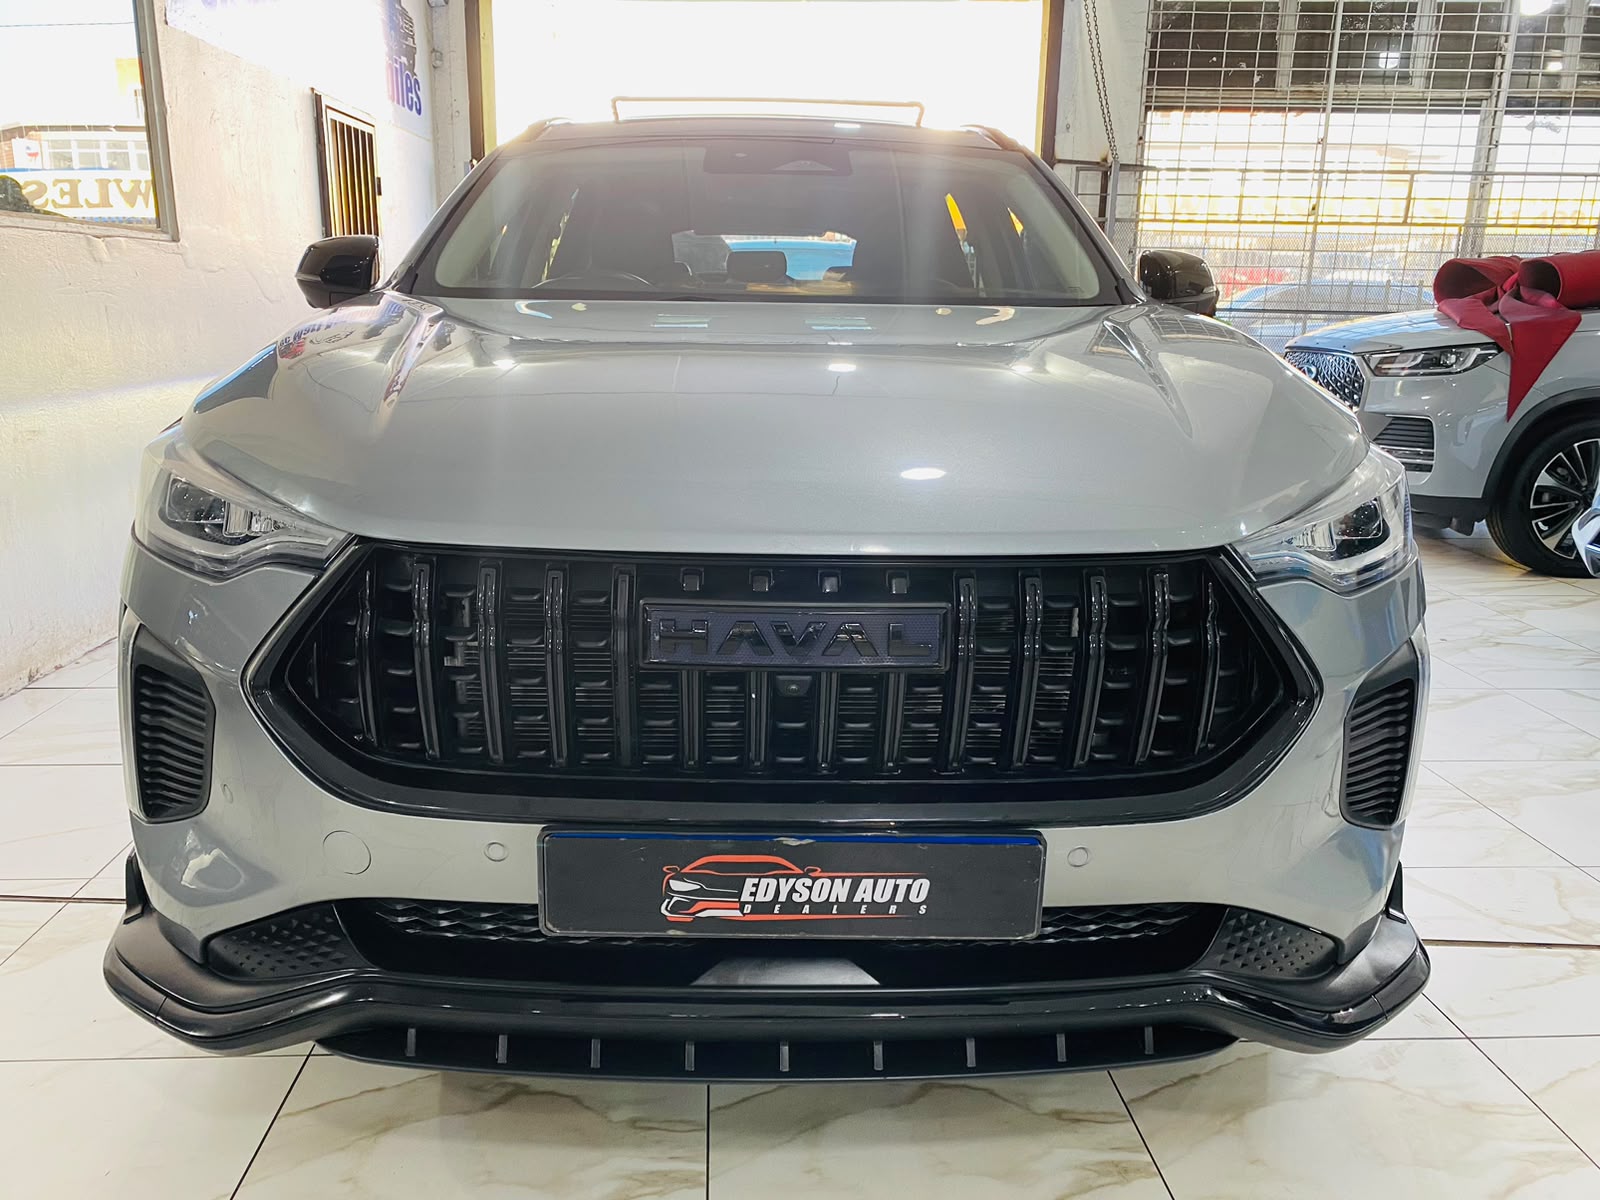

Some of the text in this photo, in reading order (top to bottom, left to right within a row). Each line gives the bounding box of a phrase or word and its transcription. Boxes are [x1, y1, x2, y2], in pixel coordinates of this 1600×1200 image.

[658, 618, 933, 657] HAVAL
[740, 877, 931, 903] EDYSON AUTO
[742, 904, 928, 915] DEALERS
